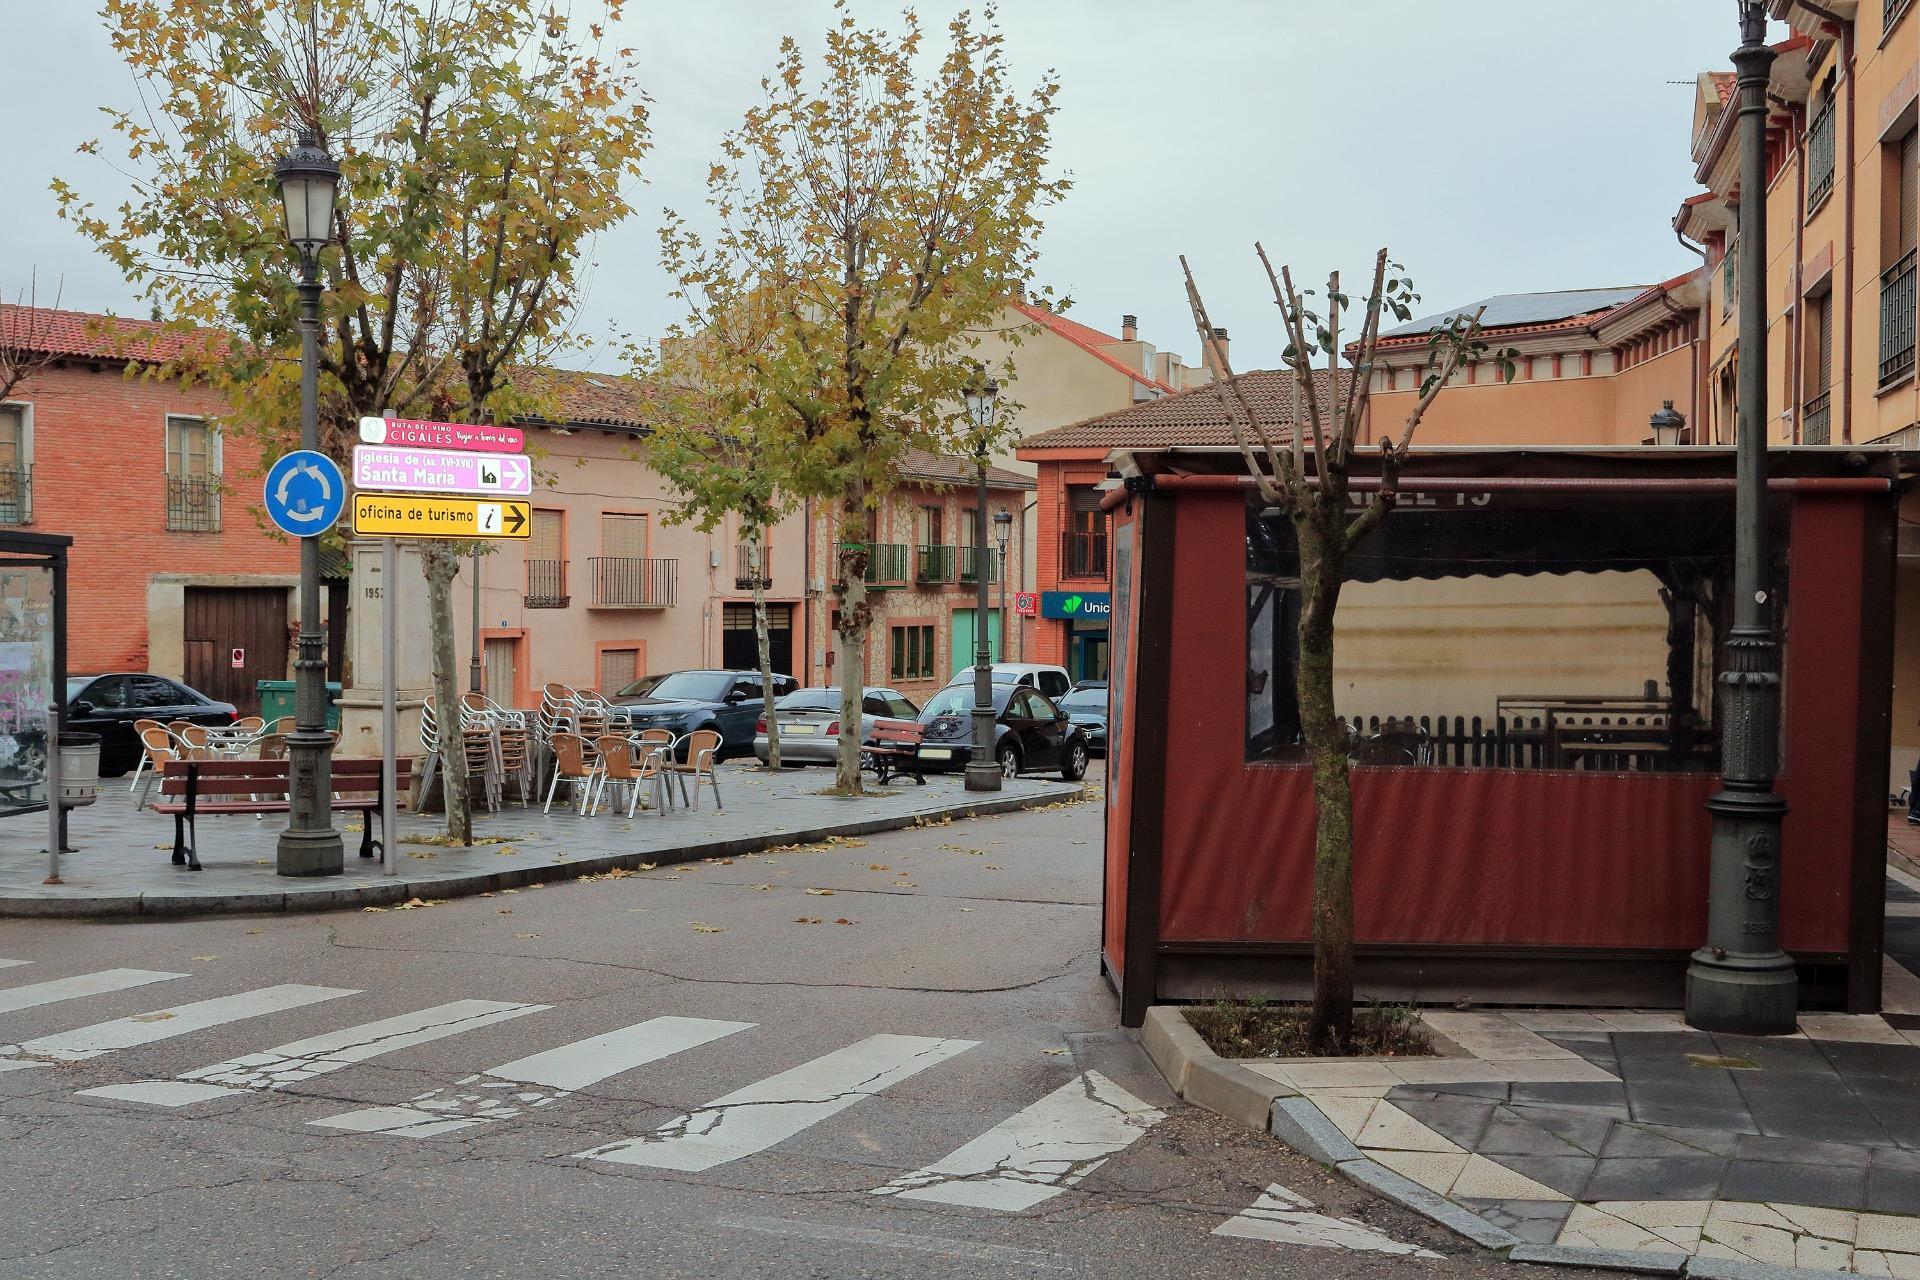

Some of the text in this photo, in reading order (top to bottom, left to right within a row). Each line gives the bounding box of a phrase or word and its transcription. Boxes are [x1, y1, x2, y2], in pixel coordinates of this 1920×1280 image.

[391, 421, 412, 429] RUTA
[390, 430, 452, 444] CIGALES
[405, 454, 420, 465] de
[360, 465, 407, 483] Santa
[360, 504, 402, 519] oficina
[408, 508, 423, 520] de
[428, 508, 474, 522] turismo
